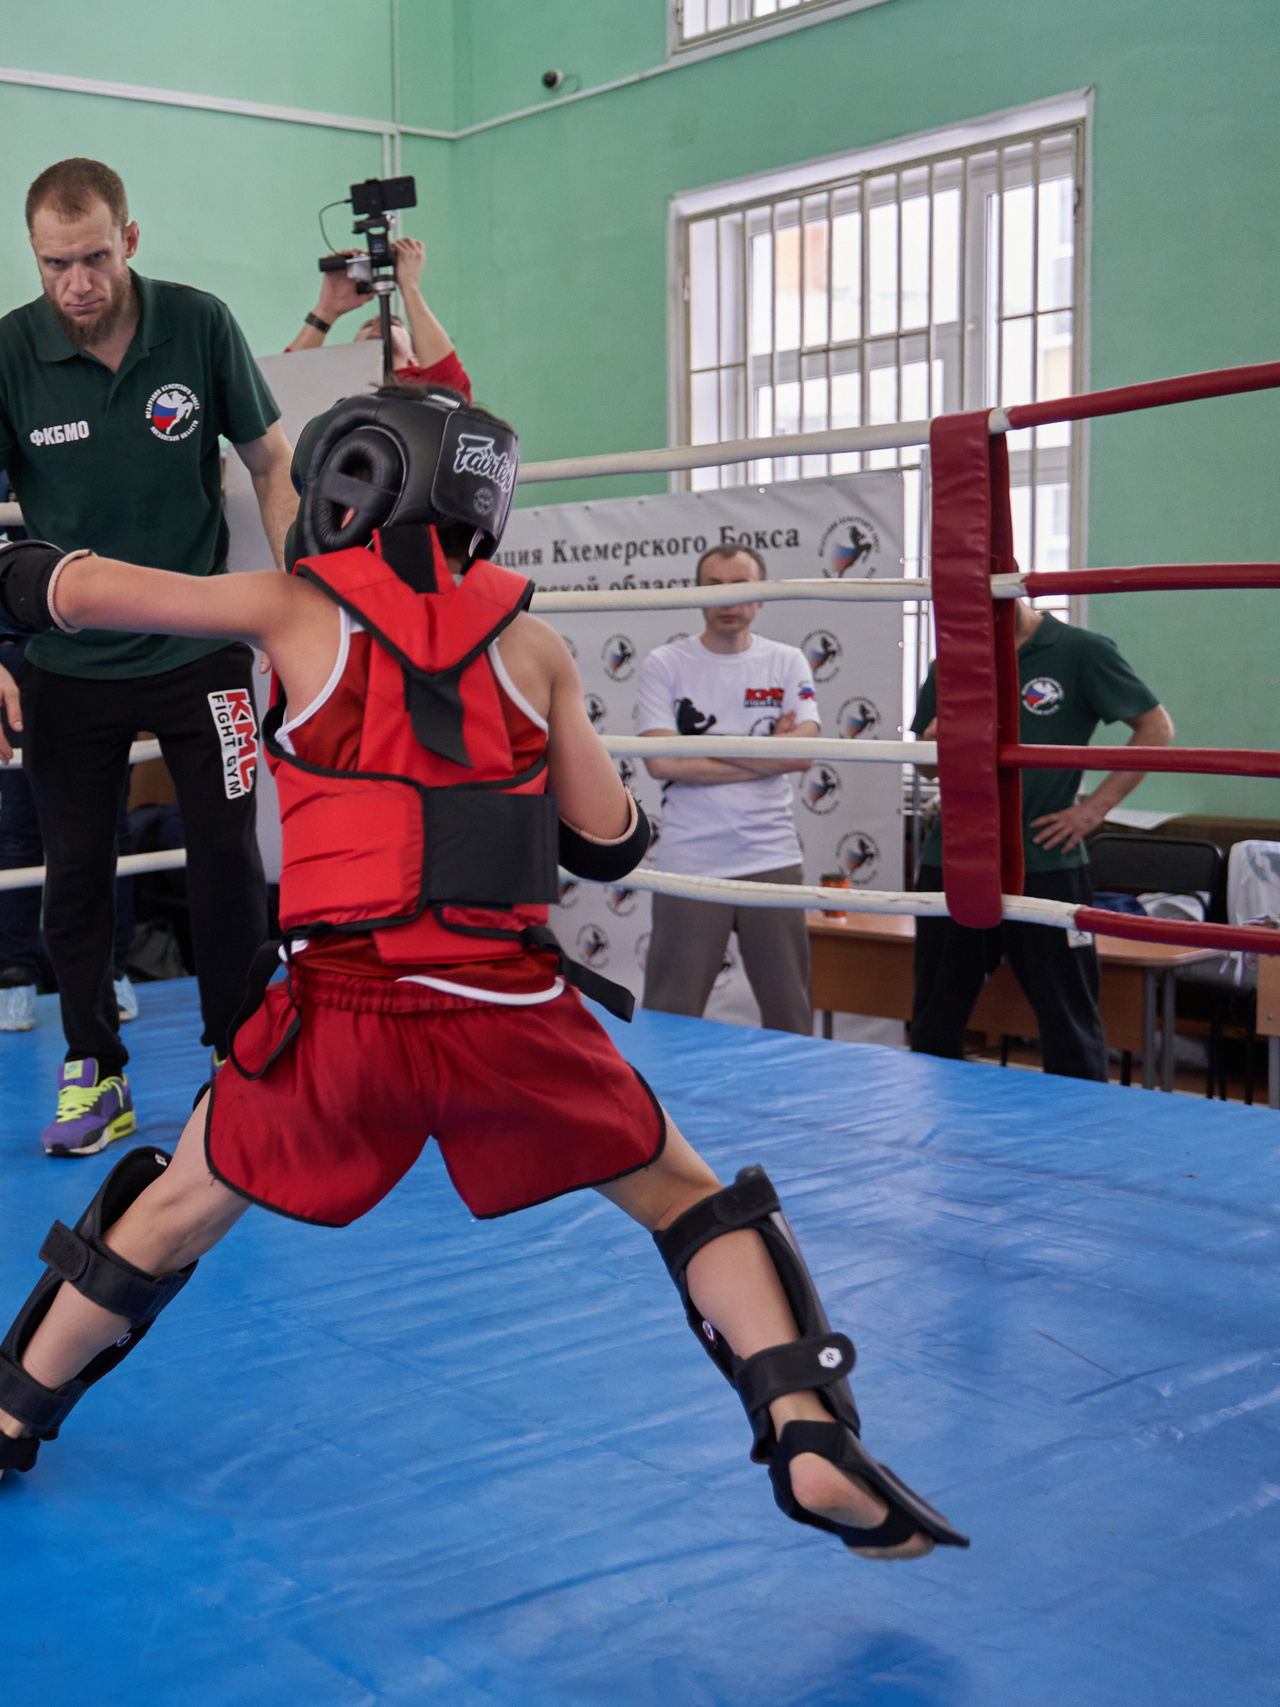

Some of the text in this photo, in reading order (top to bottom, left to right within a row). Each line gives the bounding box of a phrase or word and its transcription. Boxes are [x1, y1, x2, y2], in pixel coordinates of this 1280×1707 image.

[29, 420, 90, 447] ФКБМО
[551, 535, 707, 564] Кхемерского
[719, 525, 800, 551] Бокса
[211, 694, 242, 796] FIGHT GYM
